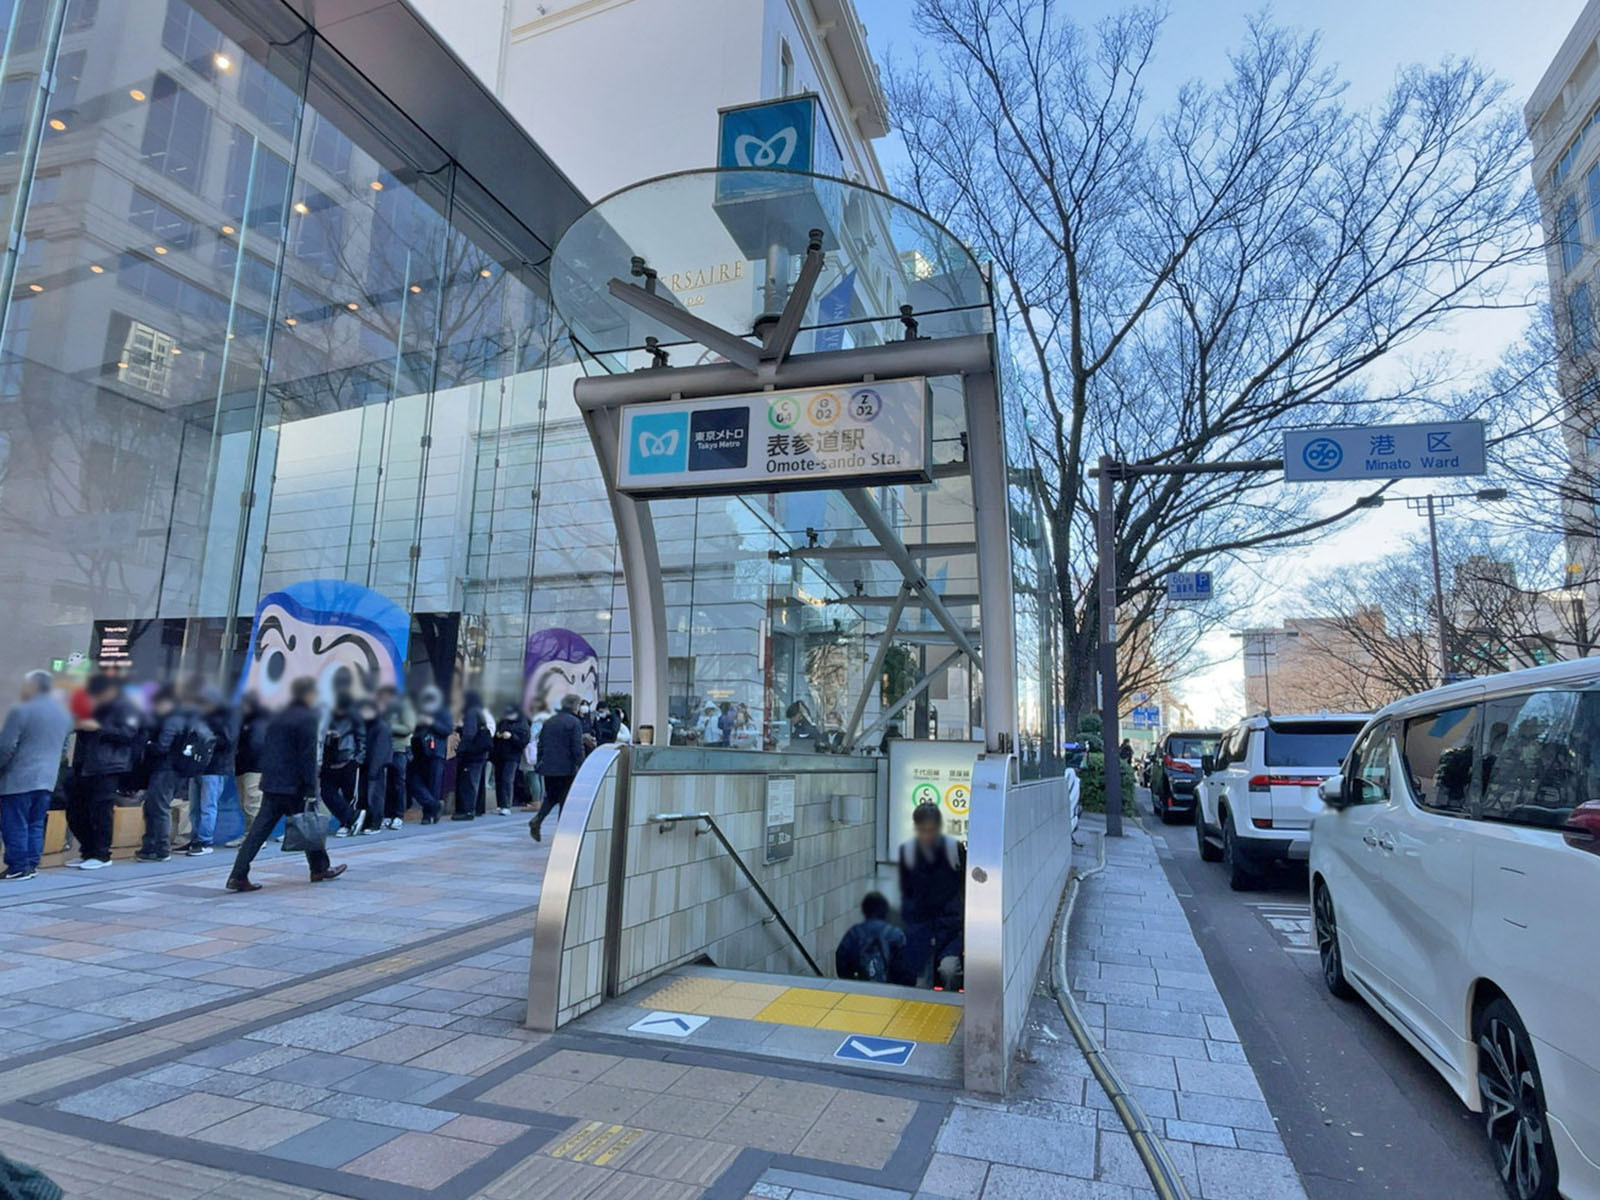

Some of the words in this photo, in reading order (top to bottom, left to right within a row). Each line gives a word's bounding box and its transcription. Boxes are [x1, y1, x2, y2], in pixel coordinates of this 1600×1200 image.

[661, 260, 742, 291] RSAIRE
[820, 398, 829, 408] G
[861, 395, 869, 404] Z
[781, 402, 788, 411] C
[856, 405, 873, 416] 02
[816, 409, 832, 420] 02
[695, 429, 744, 441] 東京メトロ
[697, 442, 718, 450] Tokyo
[719, 441, 741, 449] Metro
[767, 428, 865, 457] 表参道駅
[1369, 431, 1453, 456] 港区
[766, 454, 866, 473] Omote-sando
[871, 452, 901, 467] Sta.
[1365, 458, 1411, 471] Minato
[1420, 456, 1460, 469] Ward
[923, 788, 930, 797] C
[955, 789, 964, 798] G
[952, 799, 967, 808] 02
